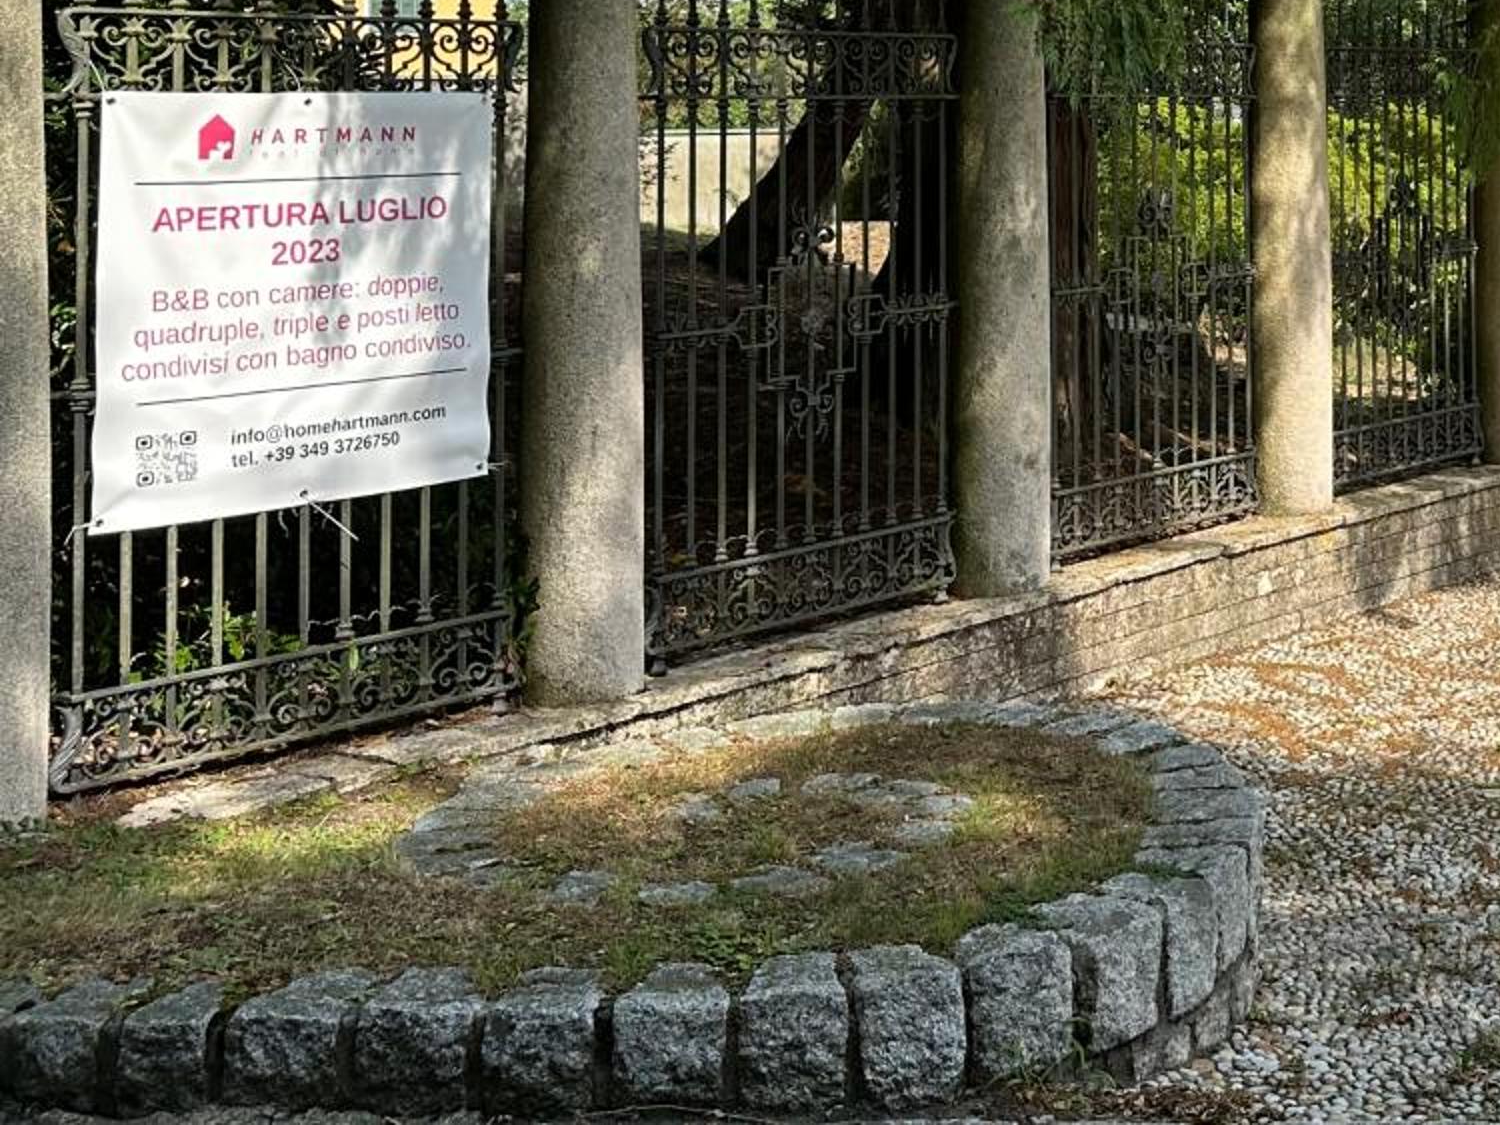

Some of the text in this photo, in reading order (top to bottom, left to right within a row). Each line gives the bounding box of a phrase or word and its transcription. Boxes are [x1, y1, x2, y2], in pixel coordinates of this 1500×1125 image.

[251, 126, 416, 145] HARTMANN
[152, 196, 447, 232] APERTURA LUGLIO
[271, 239, 340, 265] 2023
[152, 274, 444, 312] B&B con camere: doppie,
[134, 302, 460, 352] quadruple, triple e posti letto
[121, 331, 472, 382] condivisi con bagno condiviso.
[231, 406, 447, 445] info@homehartmann.com
[231, 431, 401, 467] tel. +39 349 3726750
